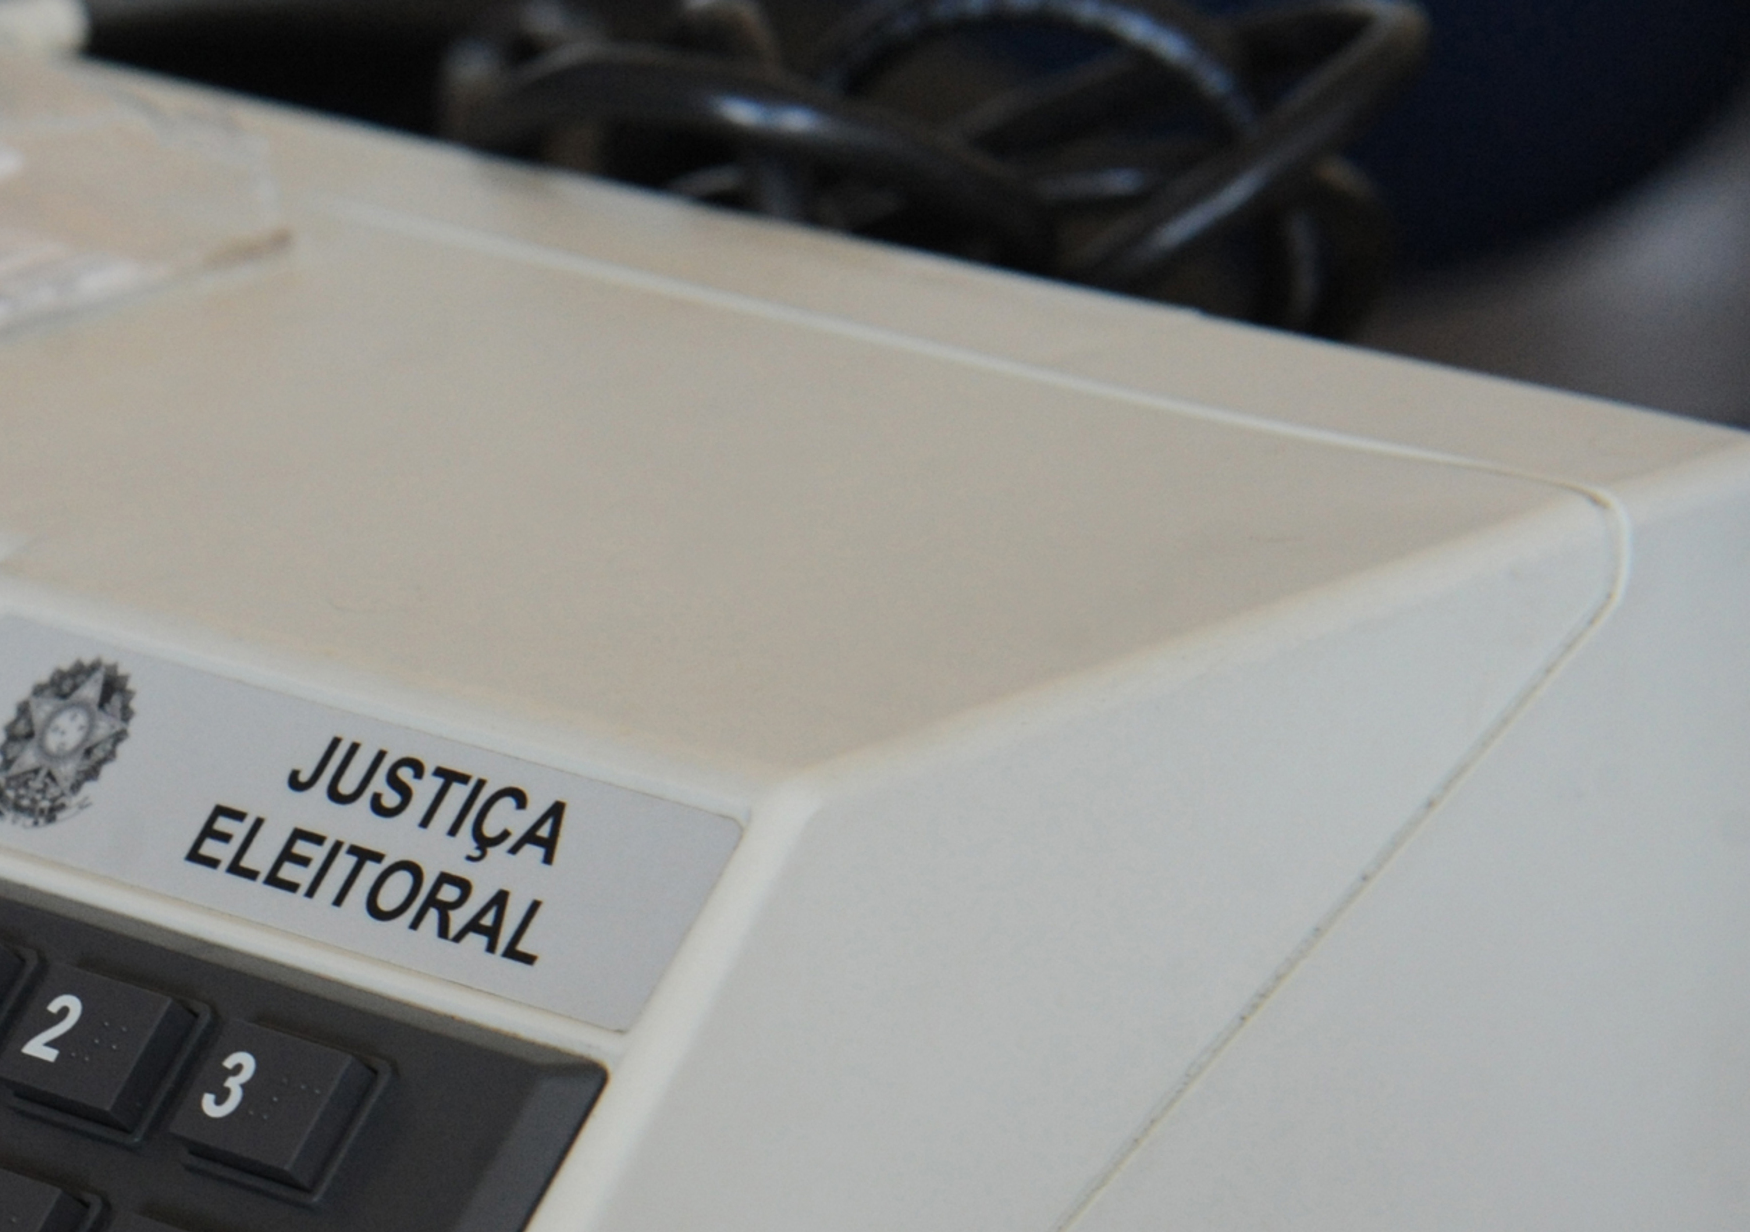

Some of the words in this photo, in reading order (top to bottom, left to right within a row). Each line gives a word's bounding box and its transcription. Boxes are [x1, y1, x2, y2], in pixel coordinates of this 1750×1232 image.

[287, 735, 570, 864] JUSTIÇA
[183, 803, 544, 966] ELEITORAL
[21, 994, 82, 1063] 2
[201, 1051, 257, 1118] 3
